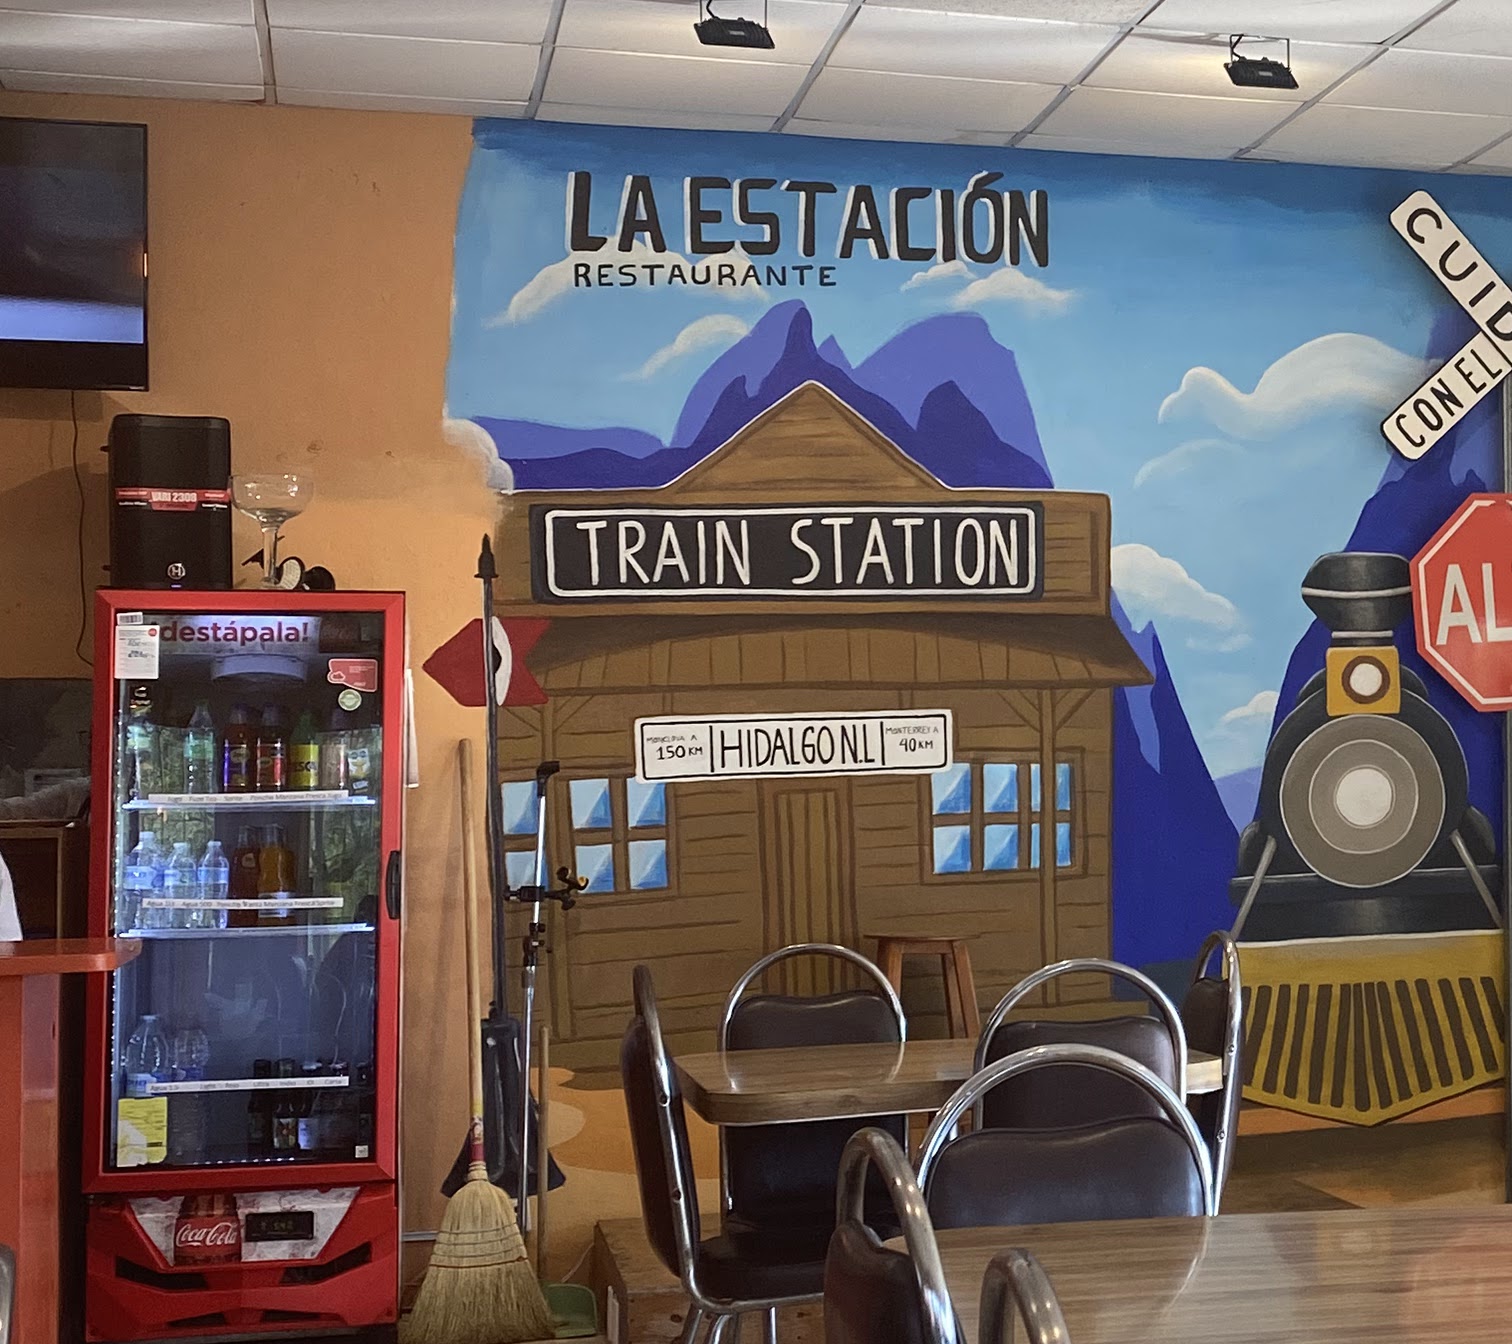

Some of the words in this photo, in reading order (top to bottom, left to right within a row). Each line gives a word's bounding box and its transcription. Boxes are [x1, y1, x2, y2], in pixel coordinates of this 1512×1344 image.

[565, 170, 668, 253] LA
[683, 170, 1049, 267] ESTACIÓN
[573, 262, 838, 289] RESTAURANTE
[1396, 377, 1464, 447] CON
[1454, 348, 1503, 394] EL
[576, 518, 751, 586] TRAIN
[791, 516, 1018, 587] STATION
[155, 620, 308, 646] destápala!
[690, 734, 698, 742] A
[885, 726, 930, 735] MONTERREY
[932, 726, 939, 734] A
[656, 744, 686, 761] 150
[688, 746, 703, 756] KM
[720, 725, 835, 769] HIDALGO
[899, 737, 917, 753] 40
[918, 740, 933, 750] KM
